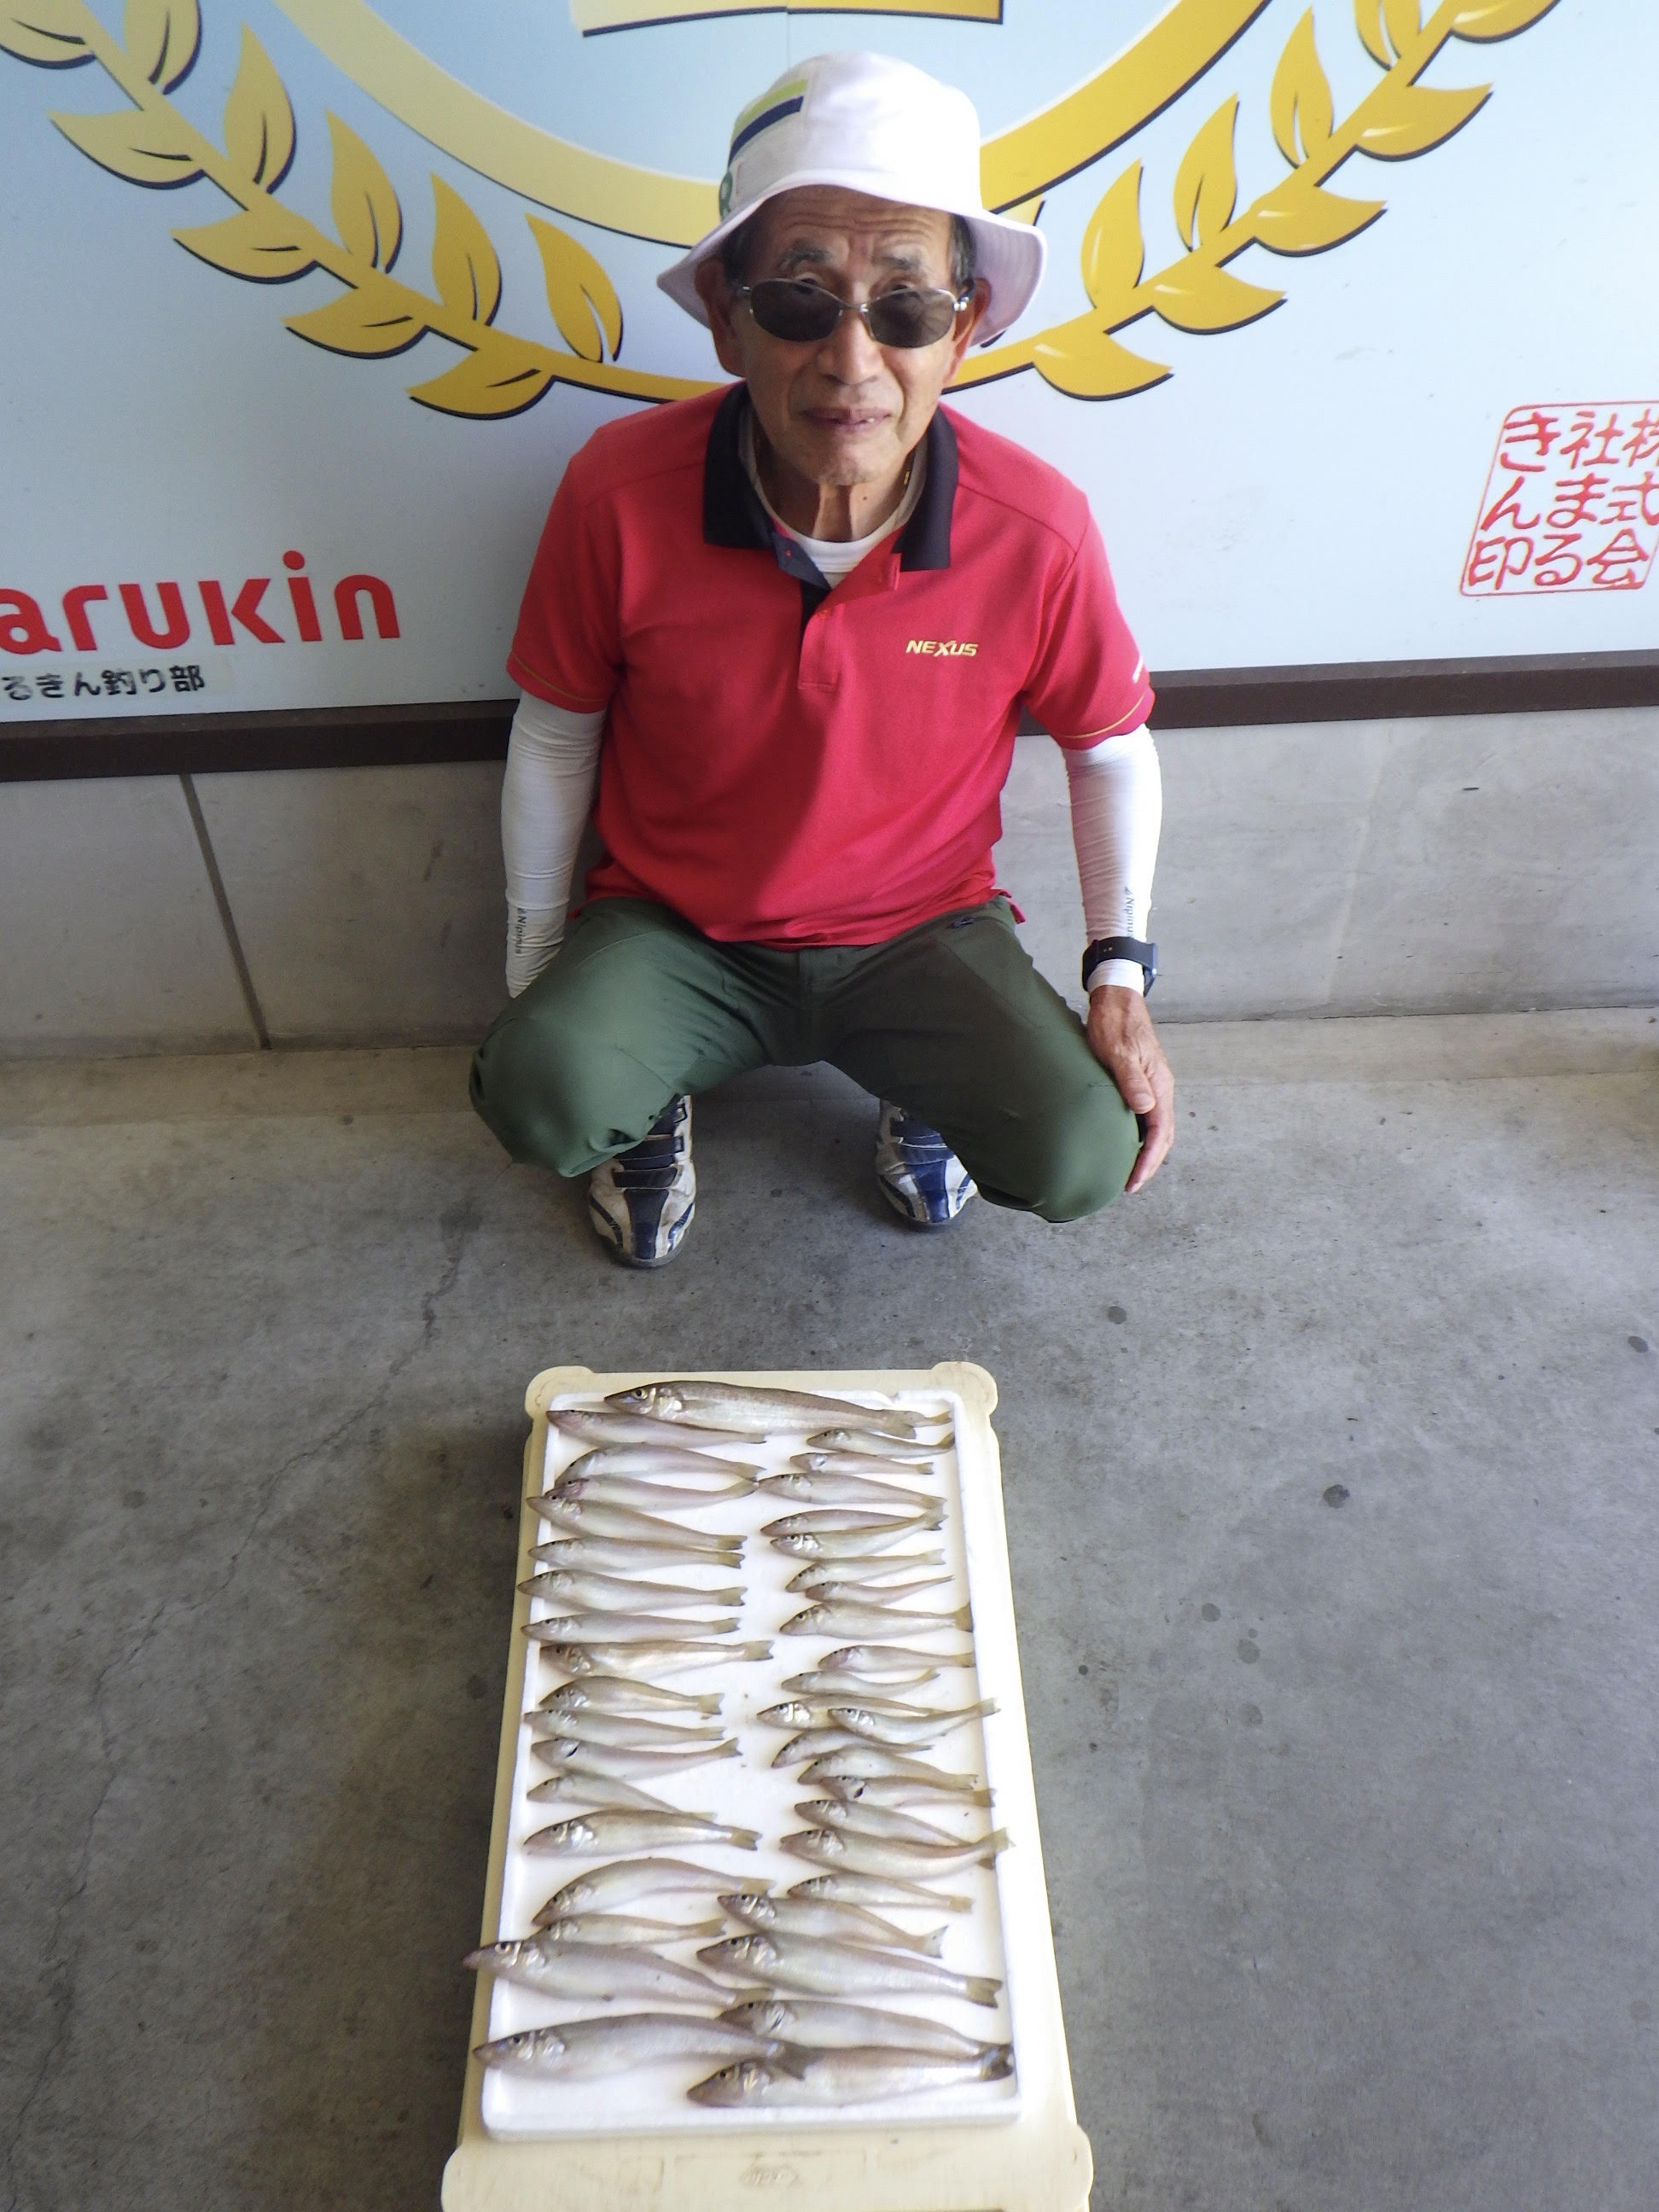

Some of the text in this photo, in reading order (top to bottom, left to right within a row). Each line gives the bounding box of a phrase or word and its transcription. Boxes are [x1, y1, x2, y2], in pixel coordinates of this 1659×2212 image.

[905, 639, 979, 657] NEXUS
[1, 665, 205, 701] るきん釣り部
